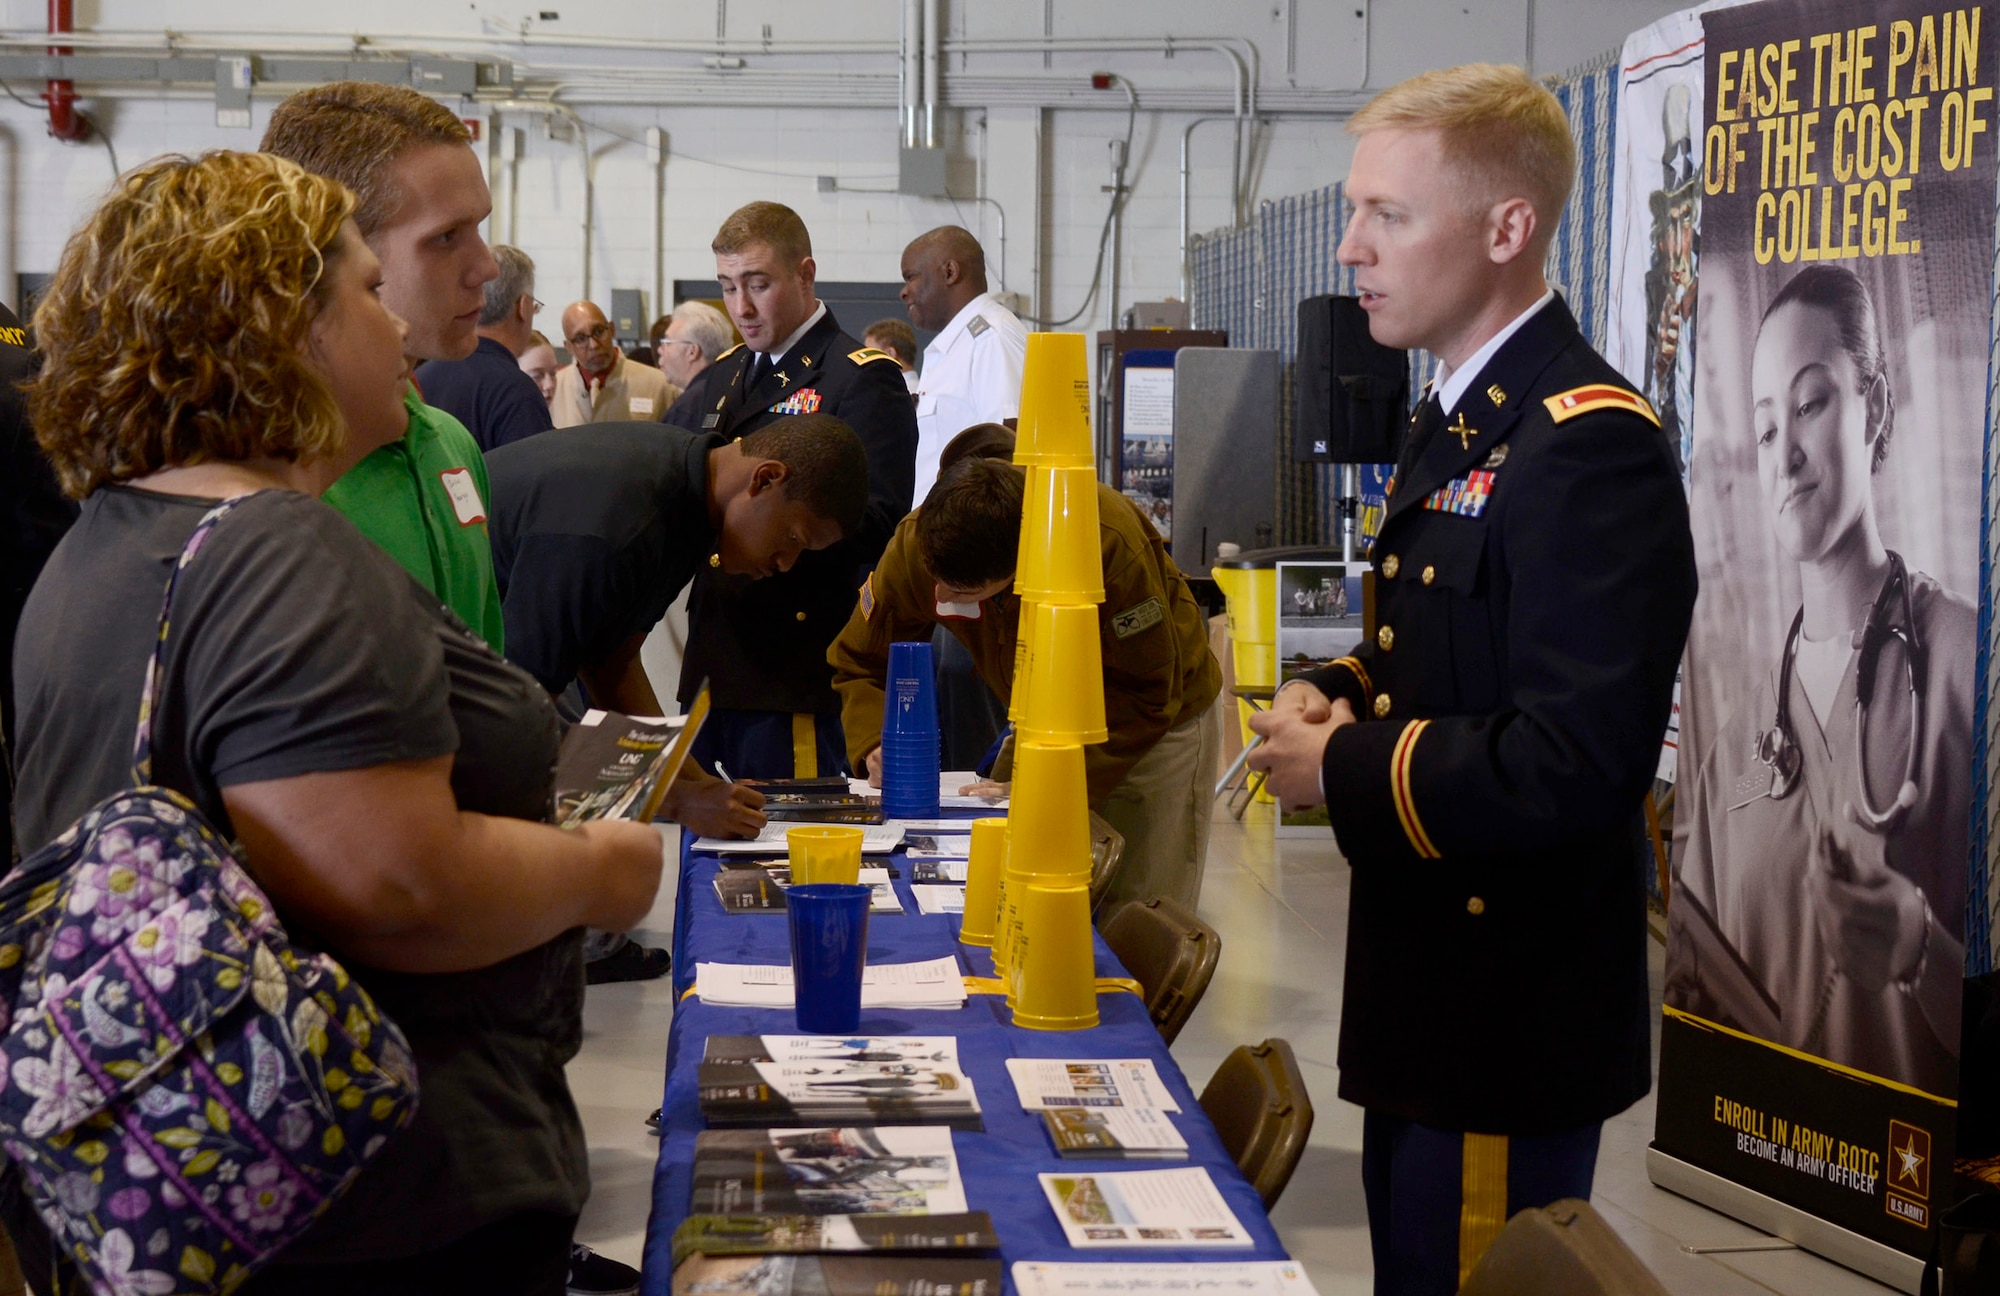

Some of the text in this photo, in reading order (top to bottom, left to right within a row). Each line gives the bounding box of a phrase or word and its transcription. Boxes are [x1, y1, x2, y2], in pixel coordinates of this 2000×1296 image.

[1716, 6, 1981, 122] EASE THE PAIN
[1704, 86, 1993, 196] OF THE COST OF
[1754, 177, 1921, 265] COLLEGE.
[1714, 1095, 1880, 1180] ENROLL IN ARMY ROTC
[1737, 1132, 1875, 1195] BECOME AN ARMY OFFICER
